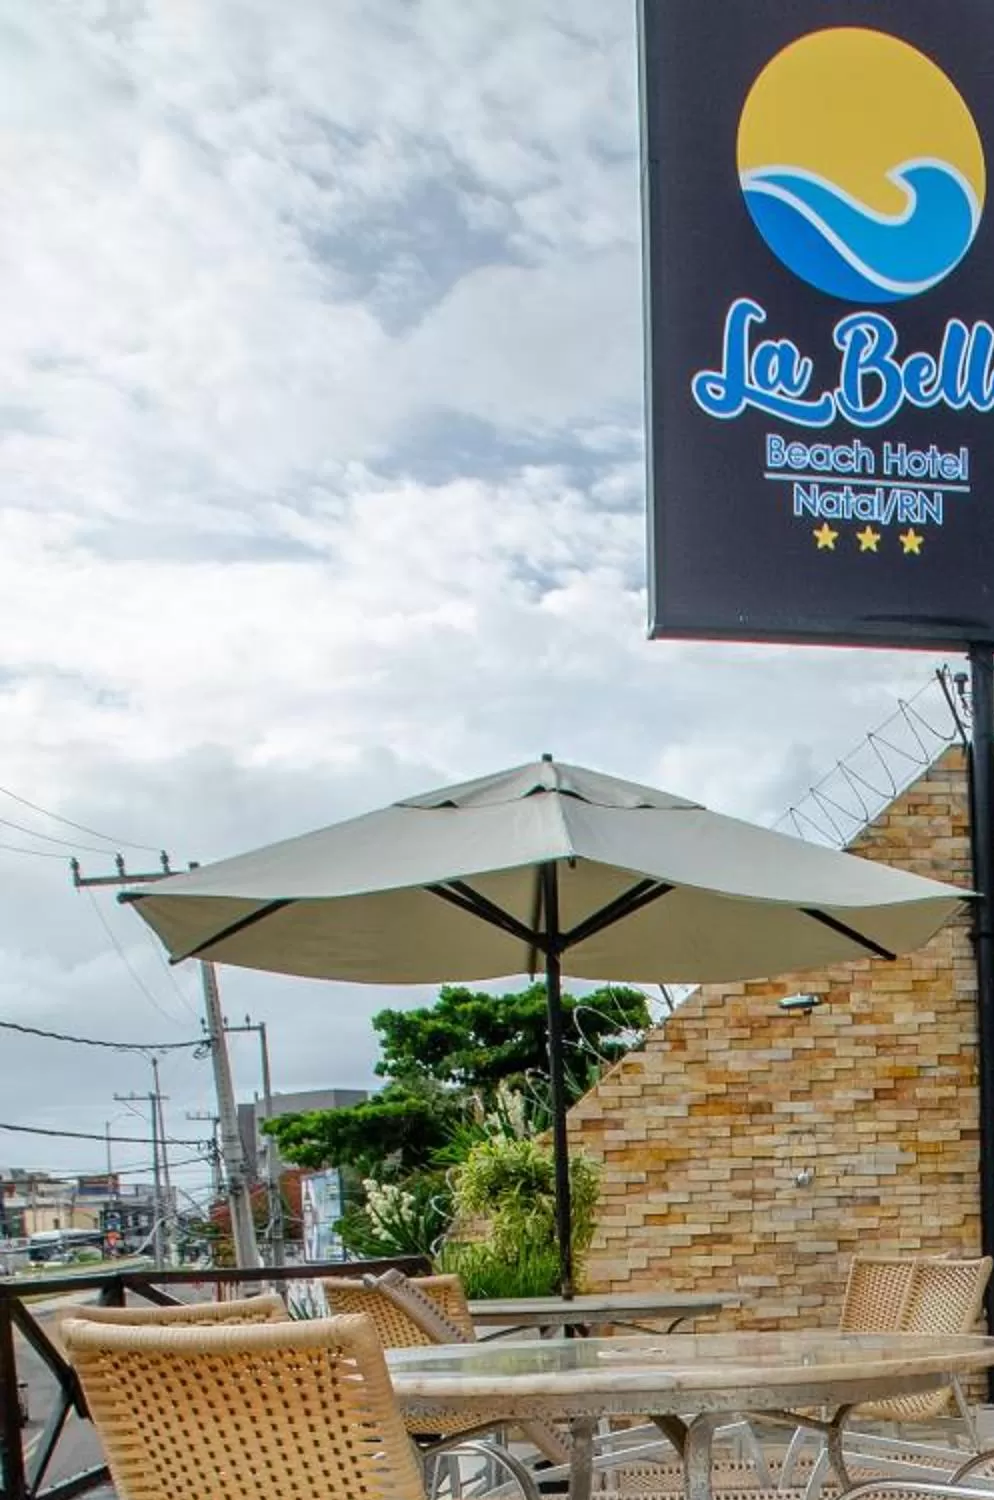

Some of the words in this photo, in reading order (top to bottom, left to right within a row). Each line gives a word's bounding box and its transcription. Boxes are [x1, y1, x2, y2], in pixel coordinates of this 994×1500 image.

[692, 299, 836, 427] La
[766, 434, 874, 474] Beach
[883, 441, 969, 480] Hotel
[793, 485, 943, 525] Natal/RN
